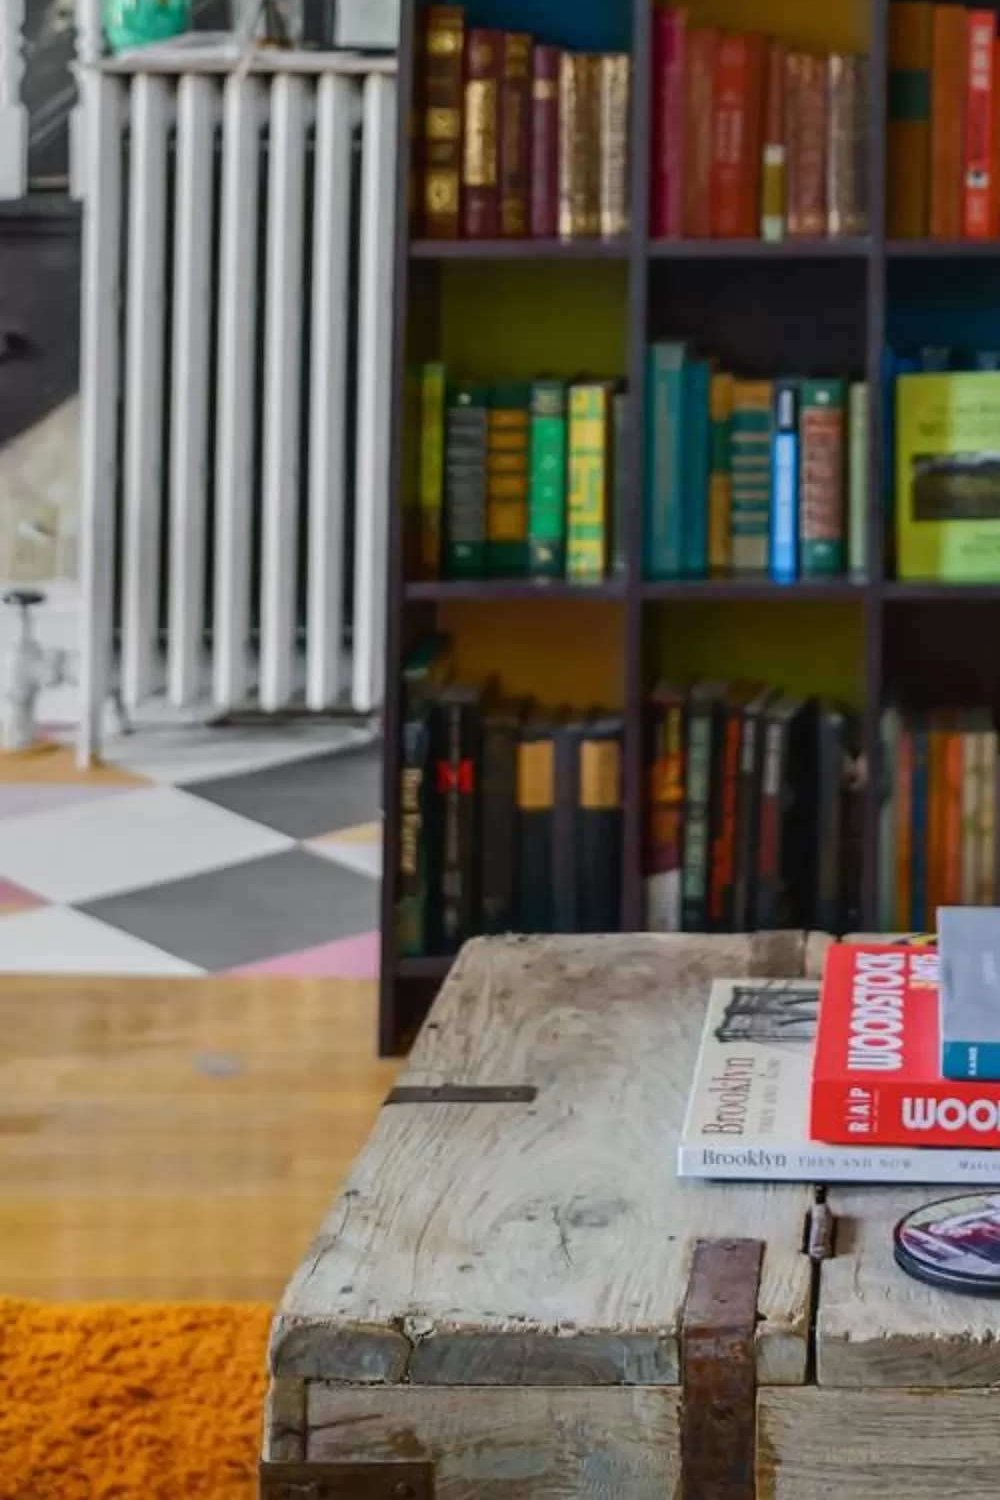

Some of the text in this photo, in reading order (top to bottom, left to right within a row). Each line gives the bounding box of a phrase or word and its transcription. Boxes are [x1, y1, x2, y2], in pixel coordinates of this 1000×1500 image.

[847, 951, 906, 1071] WOODSTOCK
[701, 1056, 758, 1136] Brooklyn
[702, 1146, 788, 1169] Brooklyn
